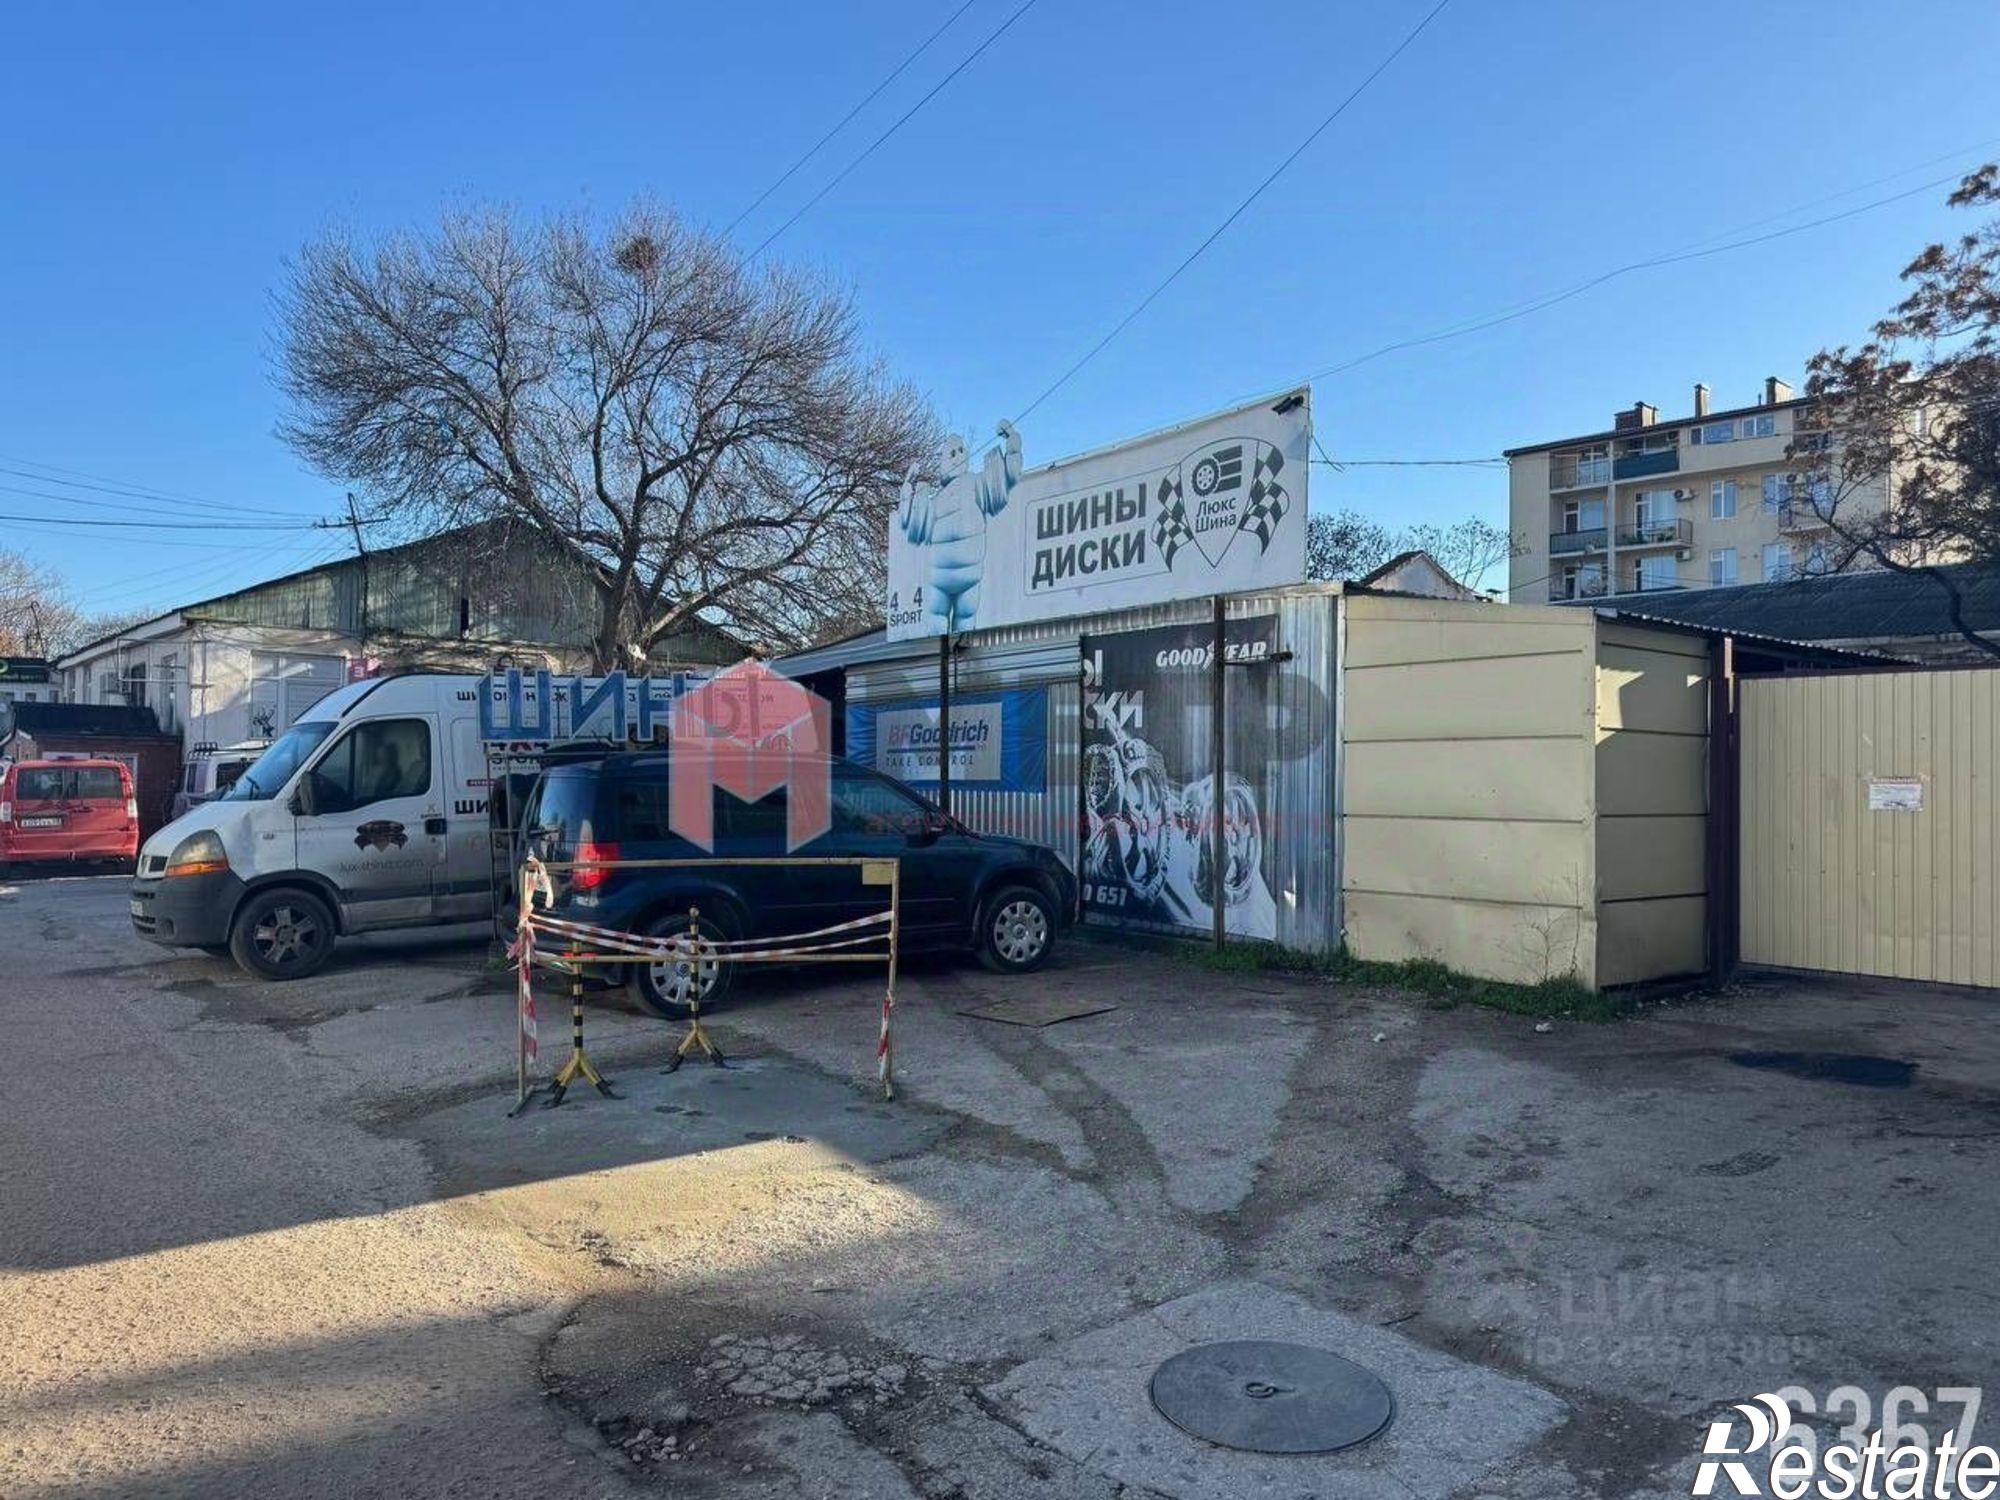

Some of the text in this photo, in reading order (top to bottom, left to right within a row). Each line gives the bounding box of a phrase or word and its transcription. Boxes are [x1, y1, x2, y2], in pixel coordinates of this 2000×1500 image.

[1036, 483, 1147, 541] ШИНЫ
[1197, 497, 1237, 518] Люкс
[1196, 513, 1237, 533] Шина
[1031, 529, 1146, 589] ДИСКИ
[914, 587, 923, 607] 4
[890, 609, 923, 627] SPORT
[1155, 641, 1267, 668] GOODEAR
[918, 754, 975, 767] CONROL
[1096, 885, 1127, 907] 651
